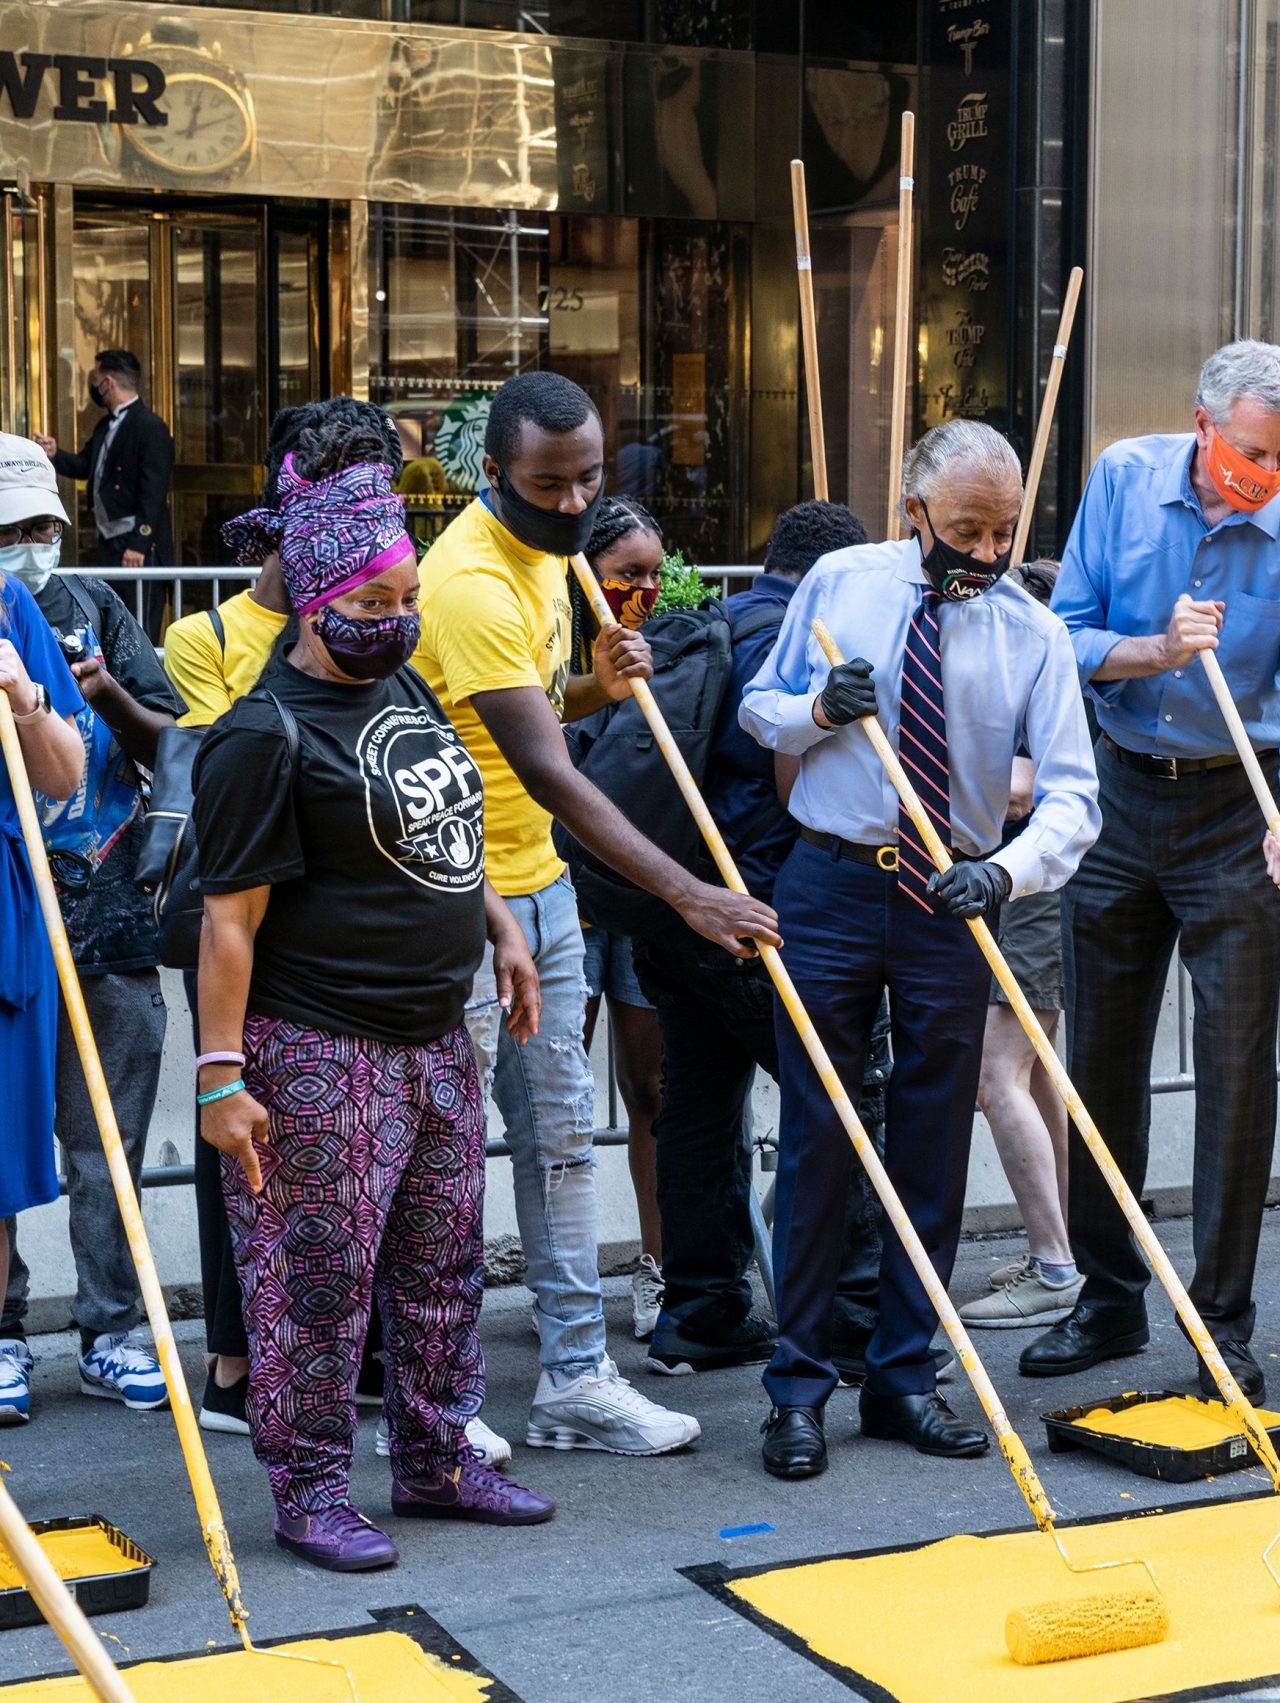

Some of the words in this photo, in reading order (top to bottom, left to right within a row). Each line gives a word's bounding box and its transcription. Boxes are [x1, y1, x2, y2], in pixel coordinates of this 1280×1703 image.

[946, 121, 989, 152] GRILL
[948, 163, 987, 187] TRUMP
[537, 285, 584, 312] 725
[394, 746, 474, 820] SPF
[407, 816, 433, 834] SPEAK
[431, 805, 454, 824] PEACE
[428, 870, 449, 884] CURE
[448, 868, 478, 885] VIOLENCE
